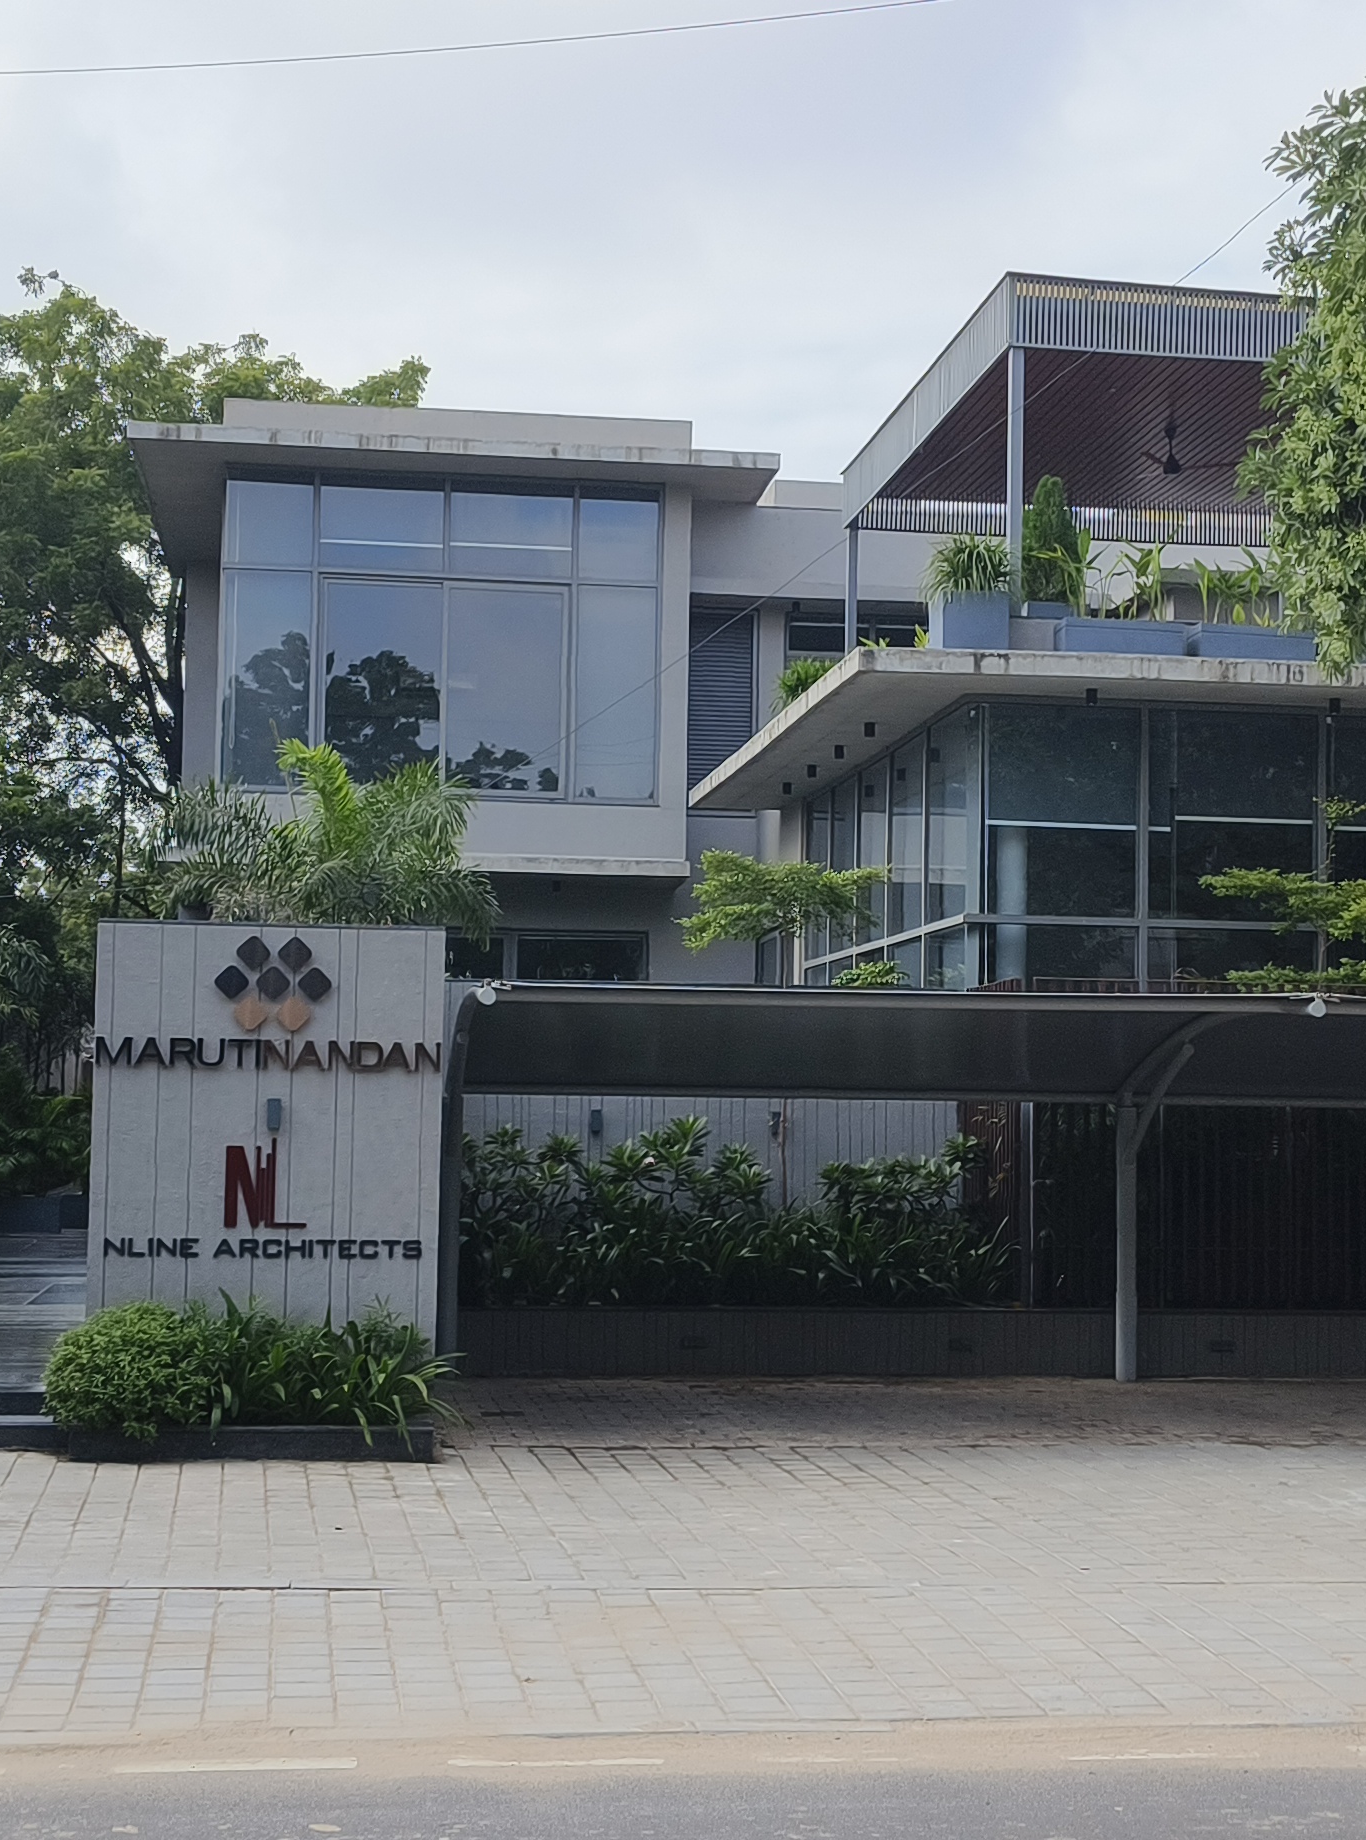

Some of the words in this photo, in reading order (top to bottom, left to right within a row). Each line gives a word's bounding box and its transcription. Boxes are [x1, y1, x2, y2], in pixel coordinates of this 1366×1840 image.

[95, 1036, 441, 1073] MARUTINANDAN
[103, 1237, 199, 1259] NLINE
[212, 1238, 423, 1260] ARCHITECTS
